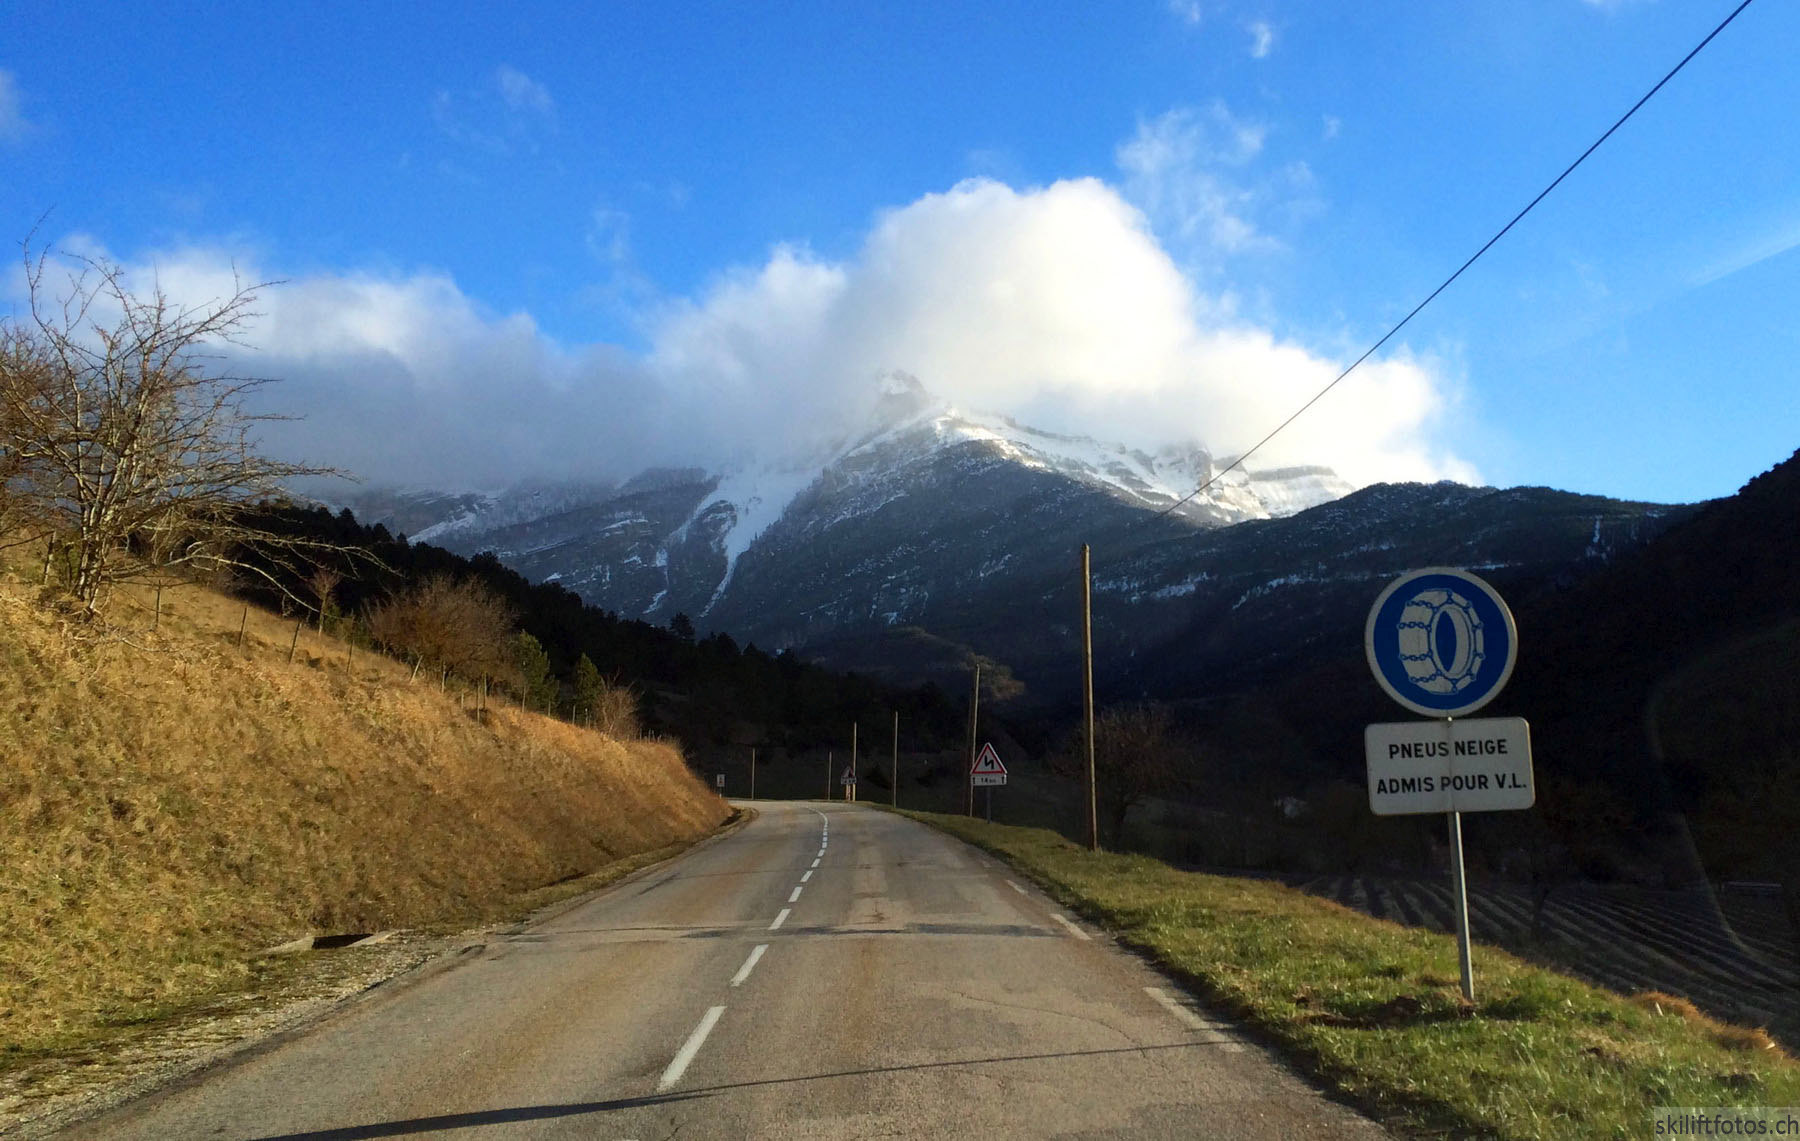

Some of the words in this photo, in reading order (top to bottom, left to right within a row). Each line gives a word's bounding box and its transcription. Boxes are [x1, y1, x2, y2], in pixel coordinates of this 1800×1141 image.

[1388, 742, 1450, 759] PNEUS
[1455, 739, 1508, 756] NEIGE
[1376, 776, 1435, 795] ADMIS
[1440, 775, 1489, 792] POUR
[1494, 773, 1527, 789] V.L.
